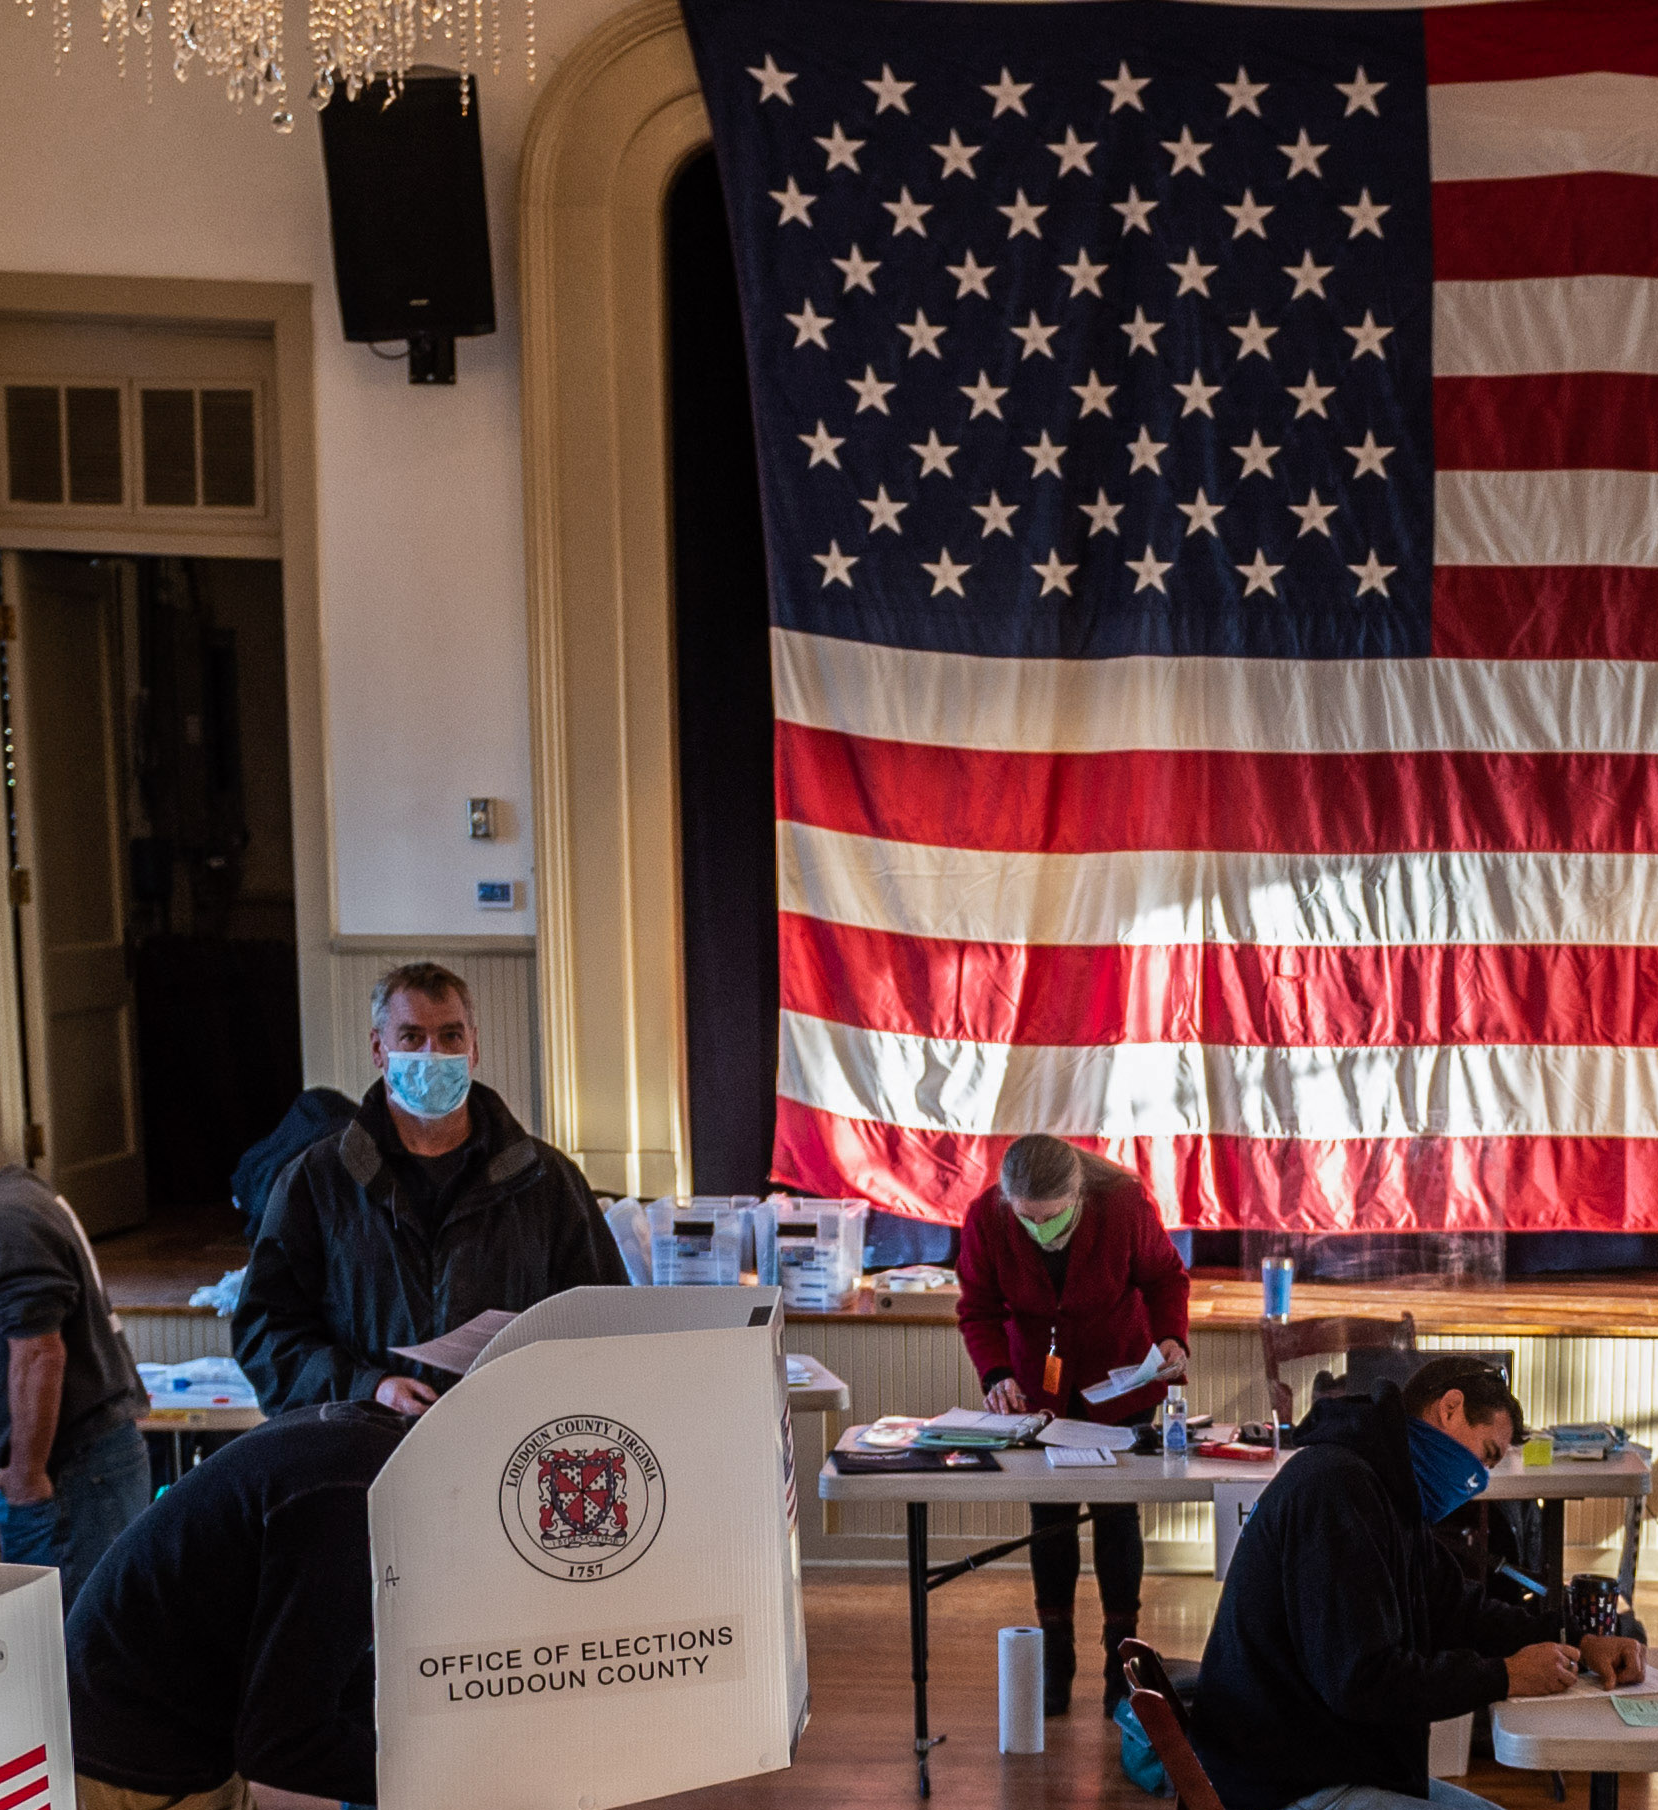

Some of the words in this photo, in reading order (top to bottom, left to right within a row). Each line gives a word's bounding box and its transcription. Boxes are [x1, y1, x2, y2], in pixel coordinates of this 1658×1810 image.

[506, 1429, 552, 1488] LOUDOUN
[555, 1420, 613, 1435] COUNTY
[617, 1429, 658, 1482] VIRGINIA
[568, 1564, 604, 1578] 1757
[419, 1650, 522, 1677] OFFICE
[533, 1645, 570, 1665] OF
[581, 1627, 733, 1661] ELECTIONS
[449, 1669, 586, 1701] LOUDOUN
[597, 1655, 709, 1685] COUNTY
